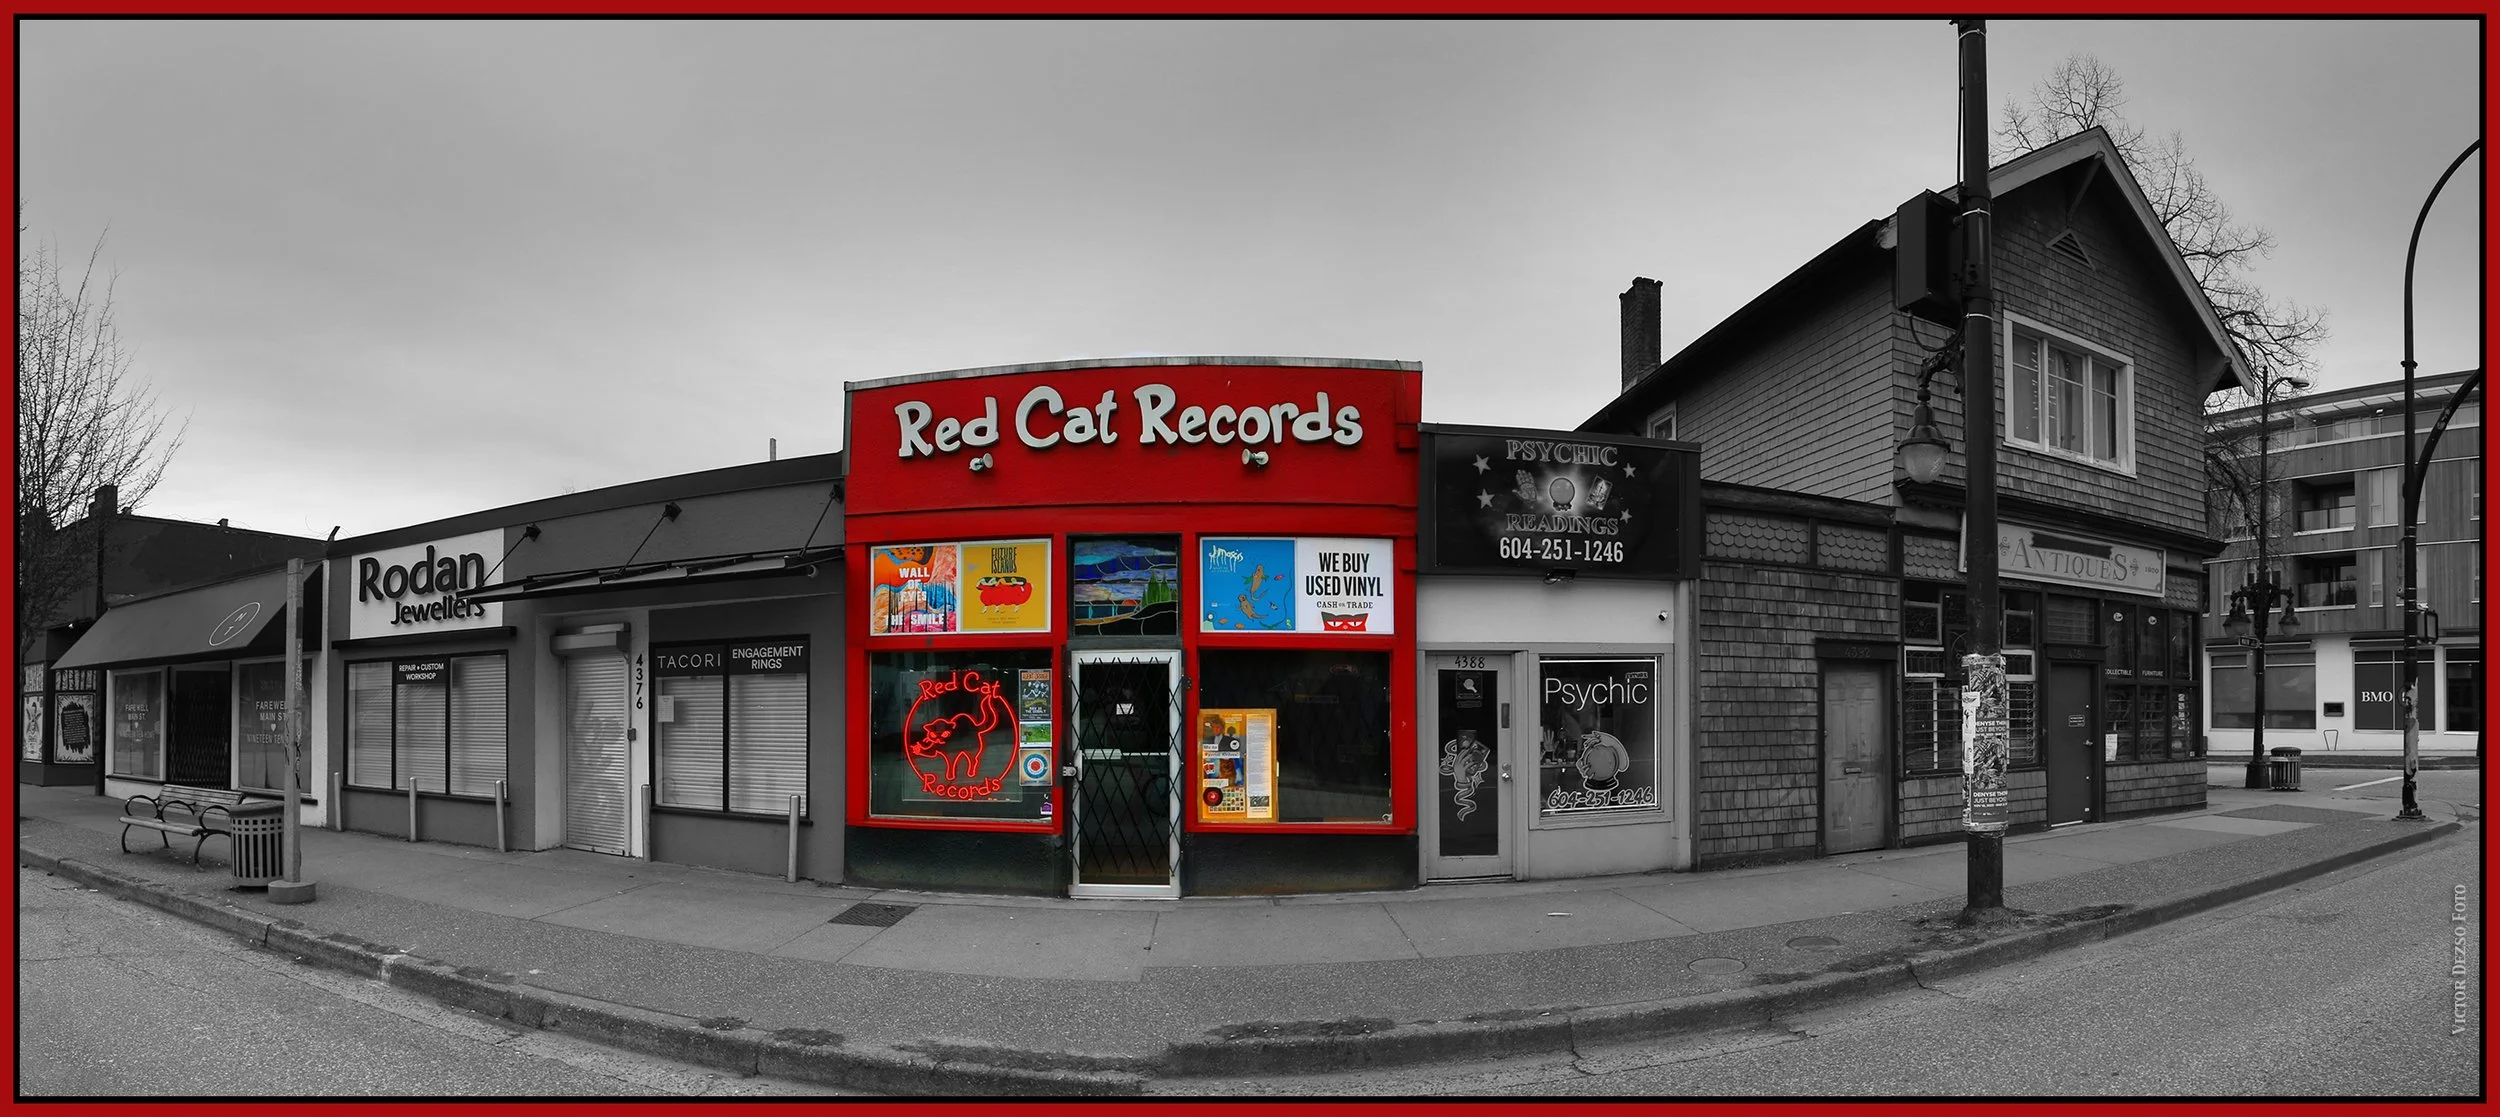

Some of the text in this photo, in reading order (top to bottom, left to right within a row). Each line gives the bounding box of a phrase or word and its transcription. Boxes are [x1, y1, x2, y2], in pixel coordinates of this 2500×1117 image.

[894, 383, 1364, 458] Red Cat Records
[1506, 439, 1618, 467] PSYCHIC
[1506, 513, 1619, 536] READINGS
[991, 547, 1017, 561] FUTURE
[1500, 537, 1624, 563] 604-251-1246
[991, 559, 1017, 574] ISLANDS
[1318, 552, 1370, 573] WE BUY
[2010, 537, 2128, 581] ANTIQUES
[358, 545, 485, 602] Rodan
[899, 567, 931, 579] WALL
[907, 579, 921, 590] OF
[1305, 576, 1384, 597] USED VINYL
[900, 590, 927, 602] EYES
[390, 595, 486, 624] Jewellers
[1316, 601, 1338, 609] CASH
[1347, 601, 1374, 609] TRADE
[884, 613, 945, 626] THE SMILE
[732, 645, 803, 659] ENGAGEMENT
[420, 663, 444, 671] CUSTOM
[657, 653, 721, 669] TACORI
[751, 658, 783, 670] RINGS
[1455, 655, 1485, 669] 4388
[405, 672, 437, 680] WORKSHOP
[636, 653, 644, 710] 4376
[918, 671, 1001, 700] Red Cat
[1545, 676, 1648, 712] Psychic
[2362, 691, 2393, 703] BMO
[125, 704, 149, 712] FAREWELL
[128, 713, 138, 721] MAIN
[260, 713, 276, 721] MAIN
[921, 773, 1001, 799] Records
[1547, 785, 1655, 809] 604-251-1246
